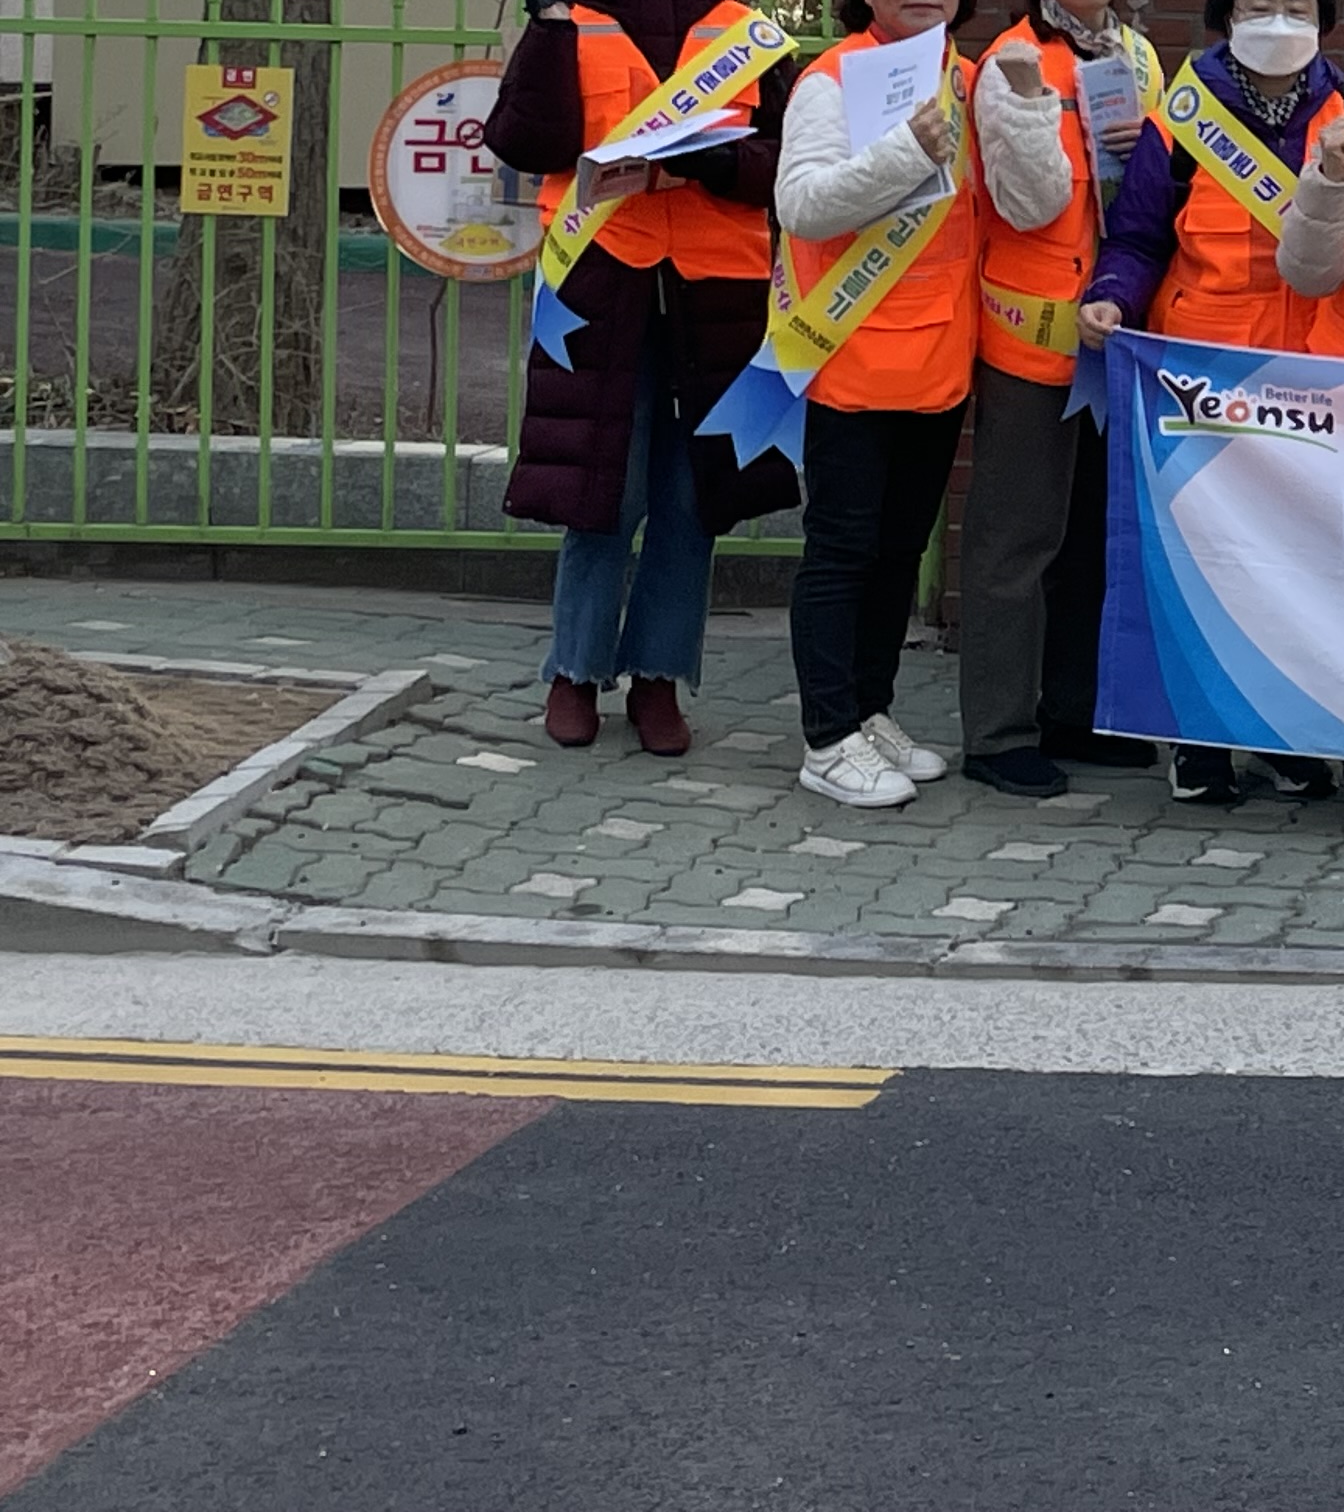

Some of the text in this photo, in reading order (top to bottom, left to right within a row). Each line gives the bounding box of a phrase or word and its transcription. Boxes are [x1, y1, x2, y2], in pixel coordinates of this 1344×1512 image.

[826, 246, 892, 323] 만들기
[1160, 374, 1335, 436] Yeonsu
[1265, 388, 1334, 408] Better life
